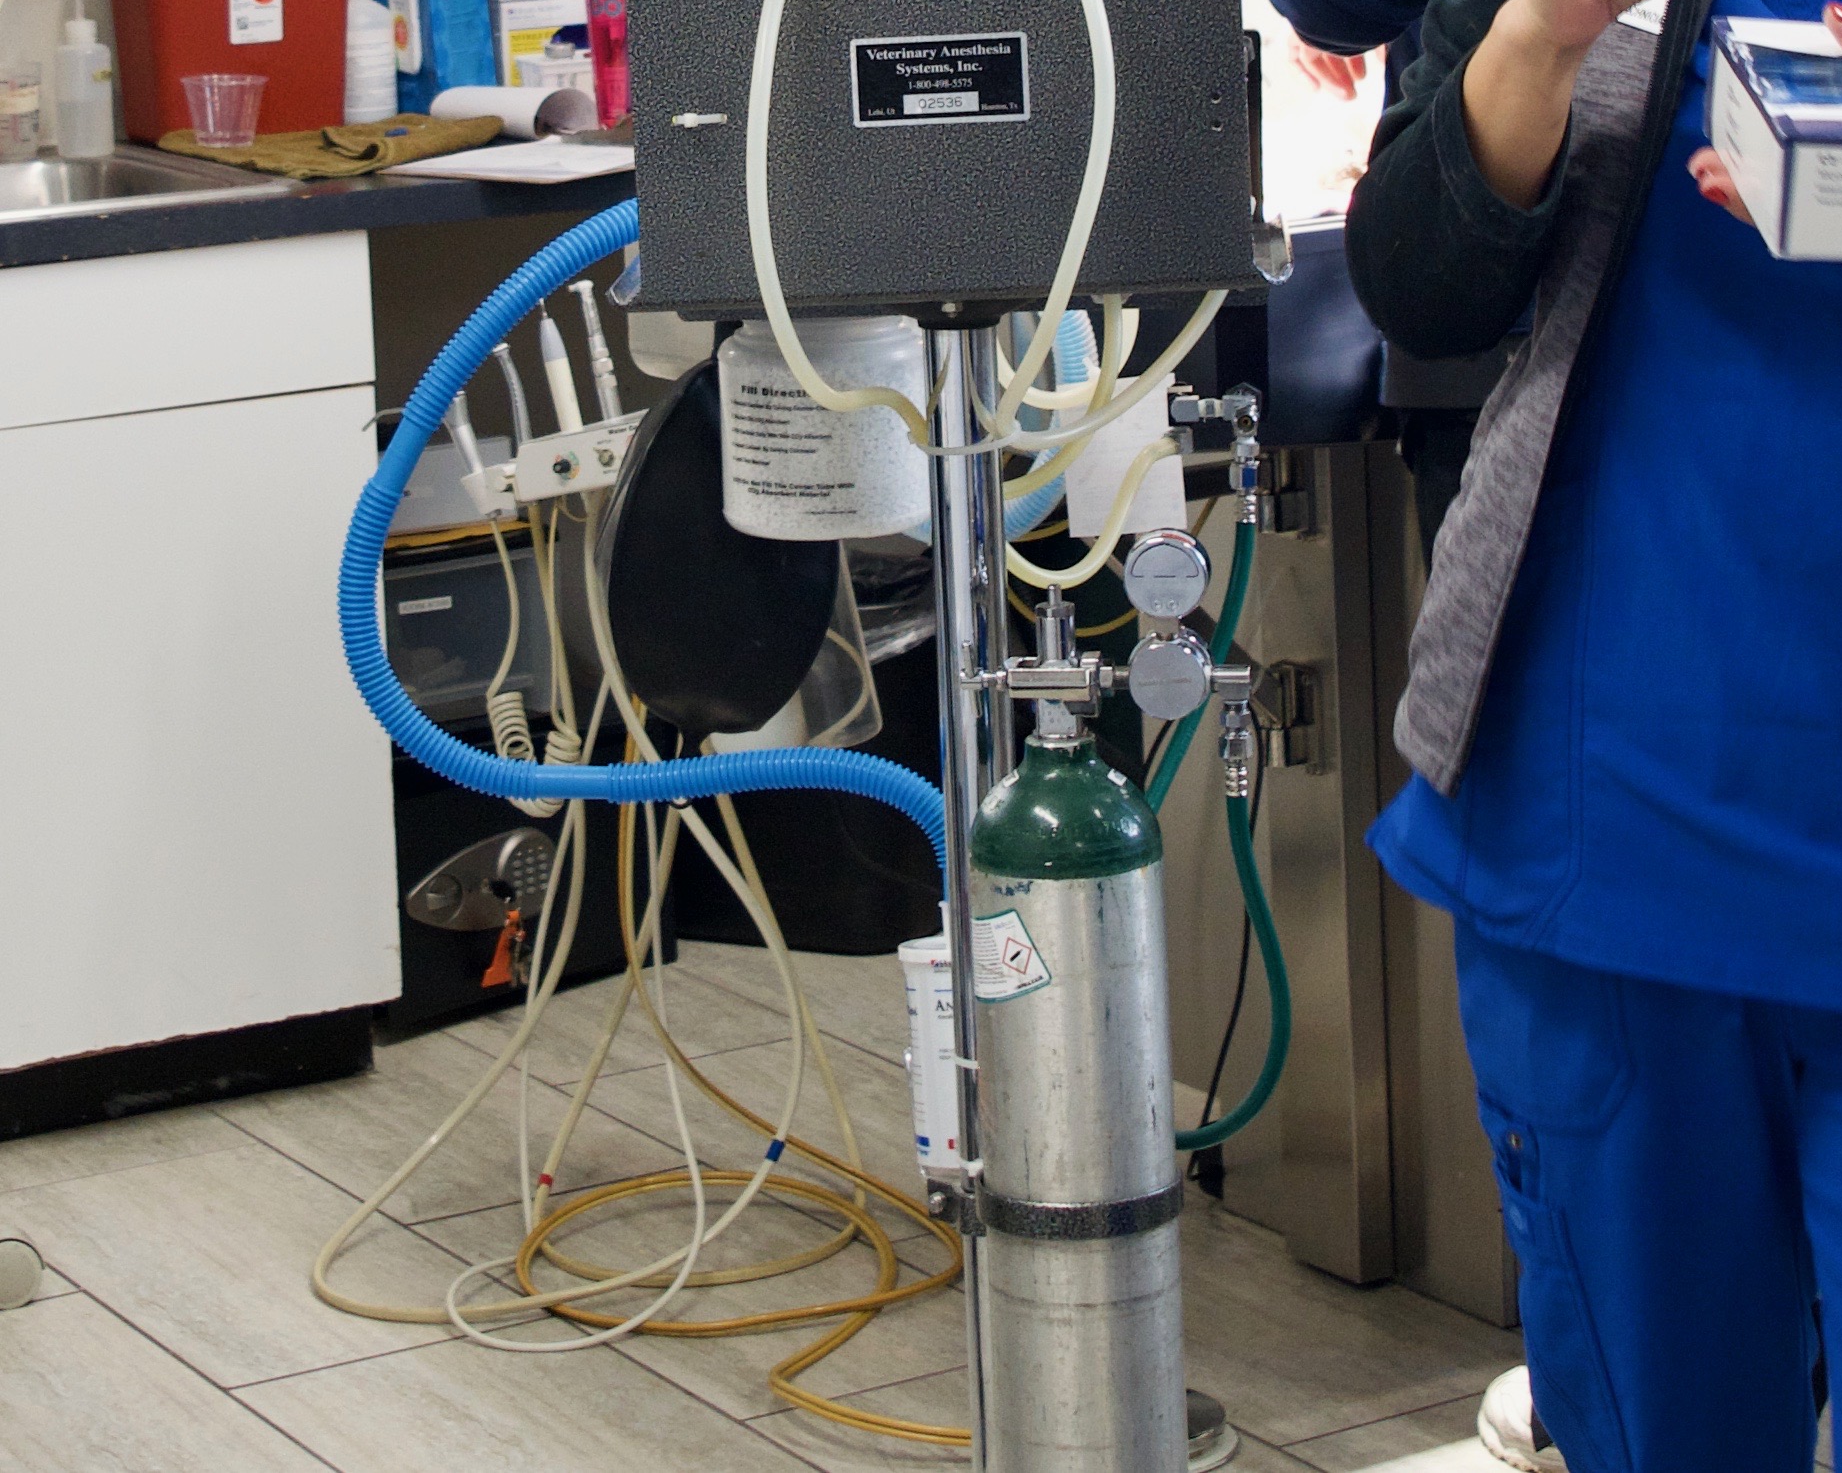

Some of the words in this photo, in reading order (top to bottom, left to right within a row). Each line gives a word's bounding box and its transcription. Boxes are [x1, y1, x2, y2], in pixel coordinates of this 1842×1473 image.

[866, 46, 937, 60] Veterinary
[940, 43, 1011, 58] Anesthesia
[896, 62, 954, 77] Systems,
[957, 61, 983, 72] Inc.
[908, 78, 973, 90] 1-800-498-5575
[918, 96, 963, 109] 02536
[741, 385, 758, 395] Fill
[761, 387, 809, 399] Directi
